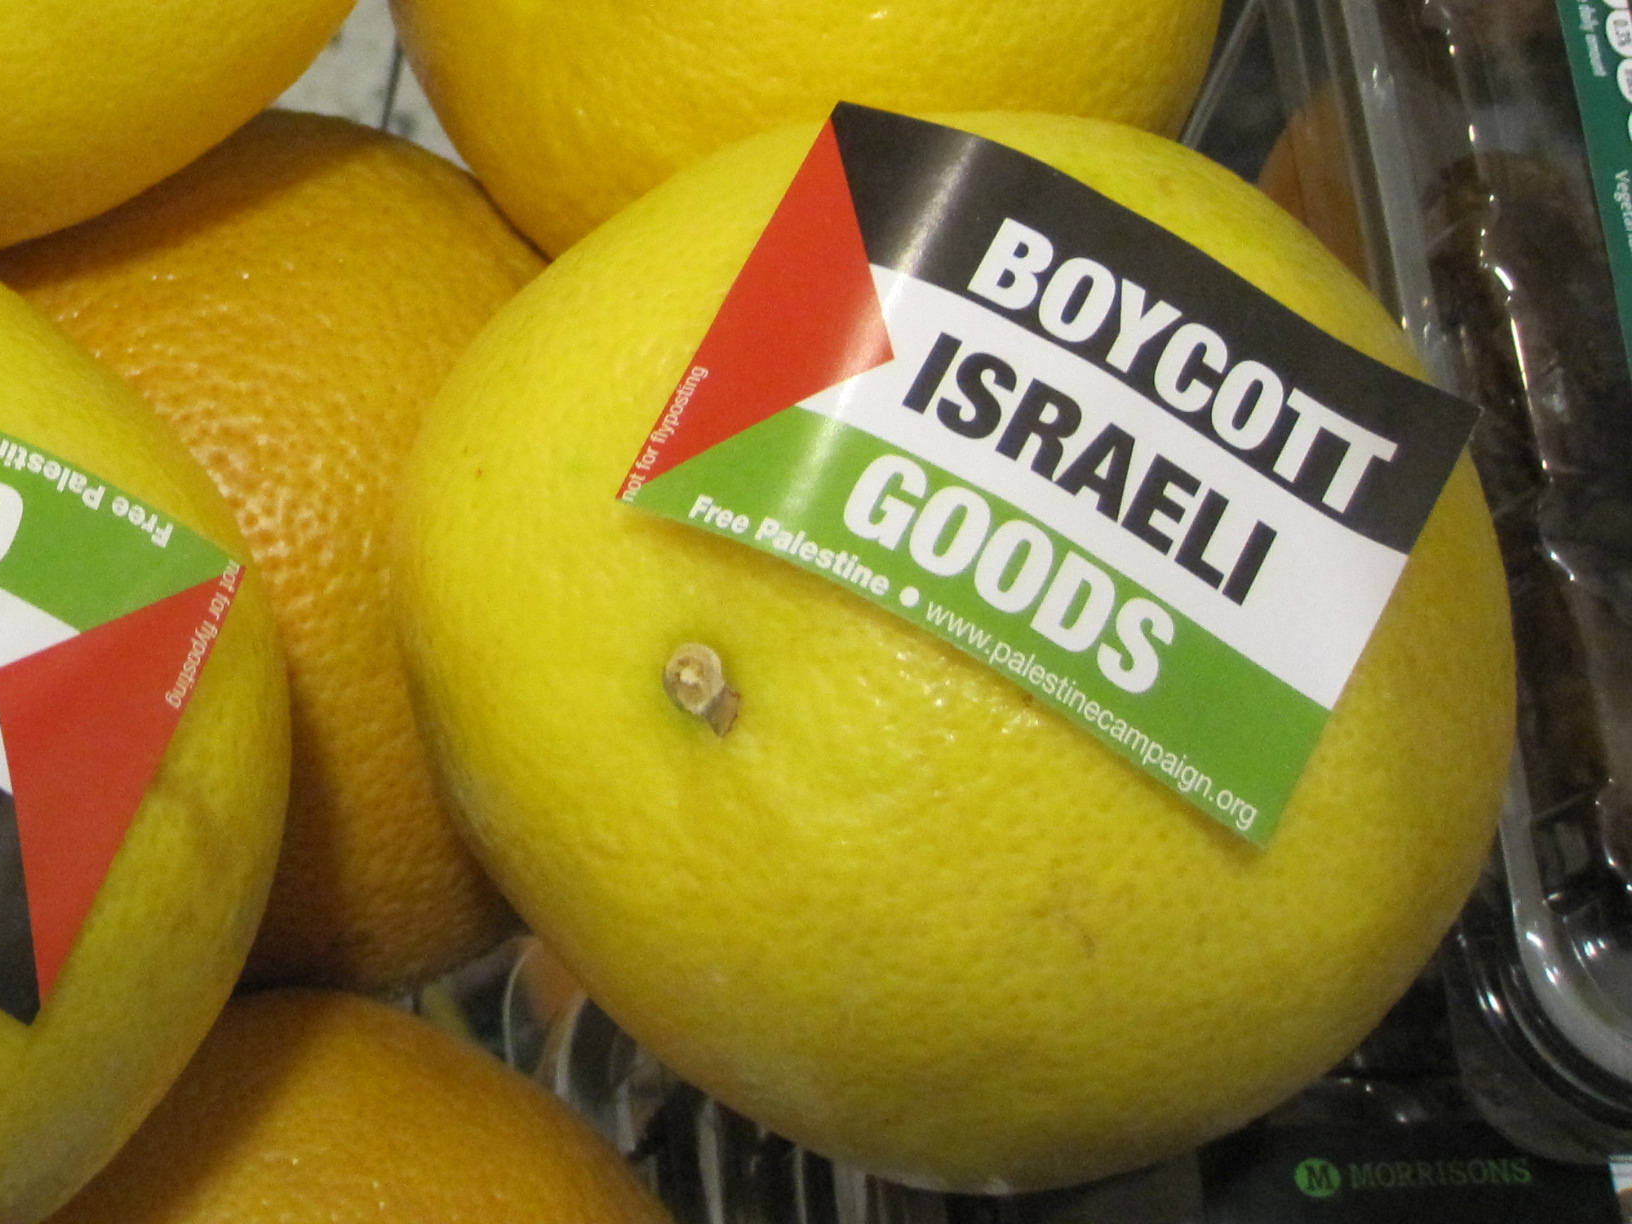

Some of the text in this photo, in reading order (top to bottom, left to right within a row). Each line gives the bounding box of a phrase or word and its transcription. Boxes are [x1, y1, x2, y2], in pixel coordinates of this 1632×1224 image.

[621, 365, 709, 503] not for flyposting
[967, 217, 1399, 516] BOYCOTT
[110, 496, 174, 548] Free
[902, 332, 1278, 608] ISRAELI
[165, 559, 240, 709] not for flyposting
[688, 495, 1259, 830] Free Palestine www.palestinecampaign.org
[842, 454, 1176, 695] GOODS
[1348, 1157, 1532, 1189] MORRISONS
